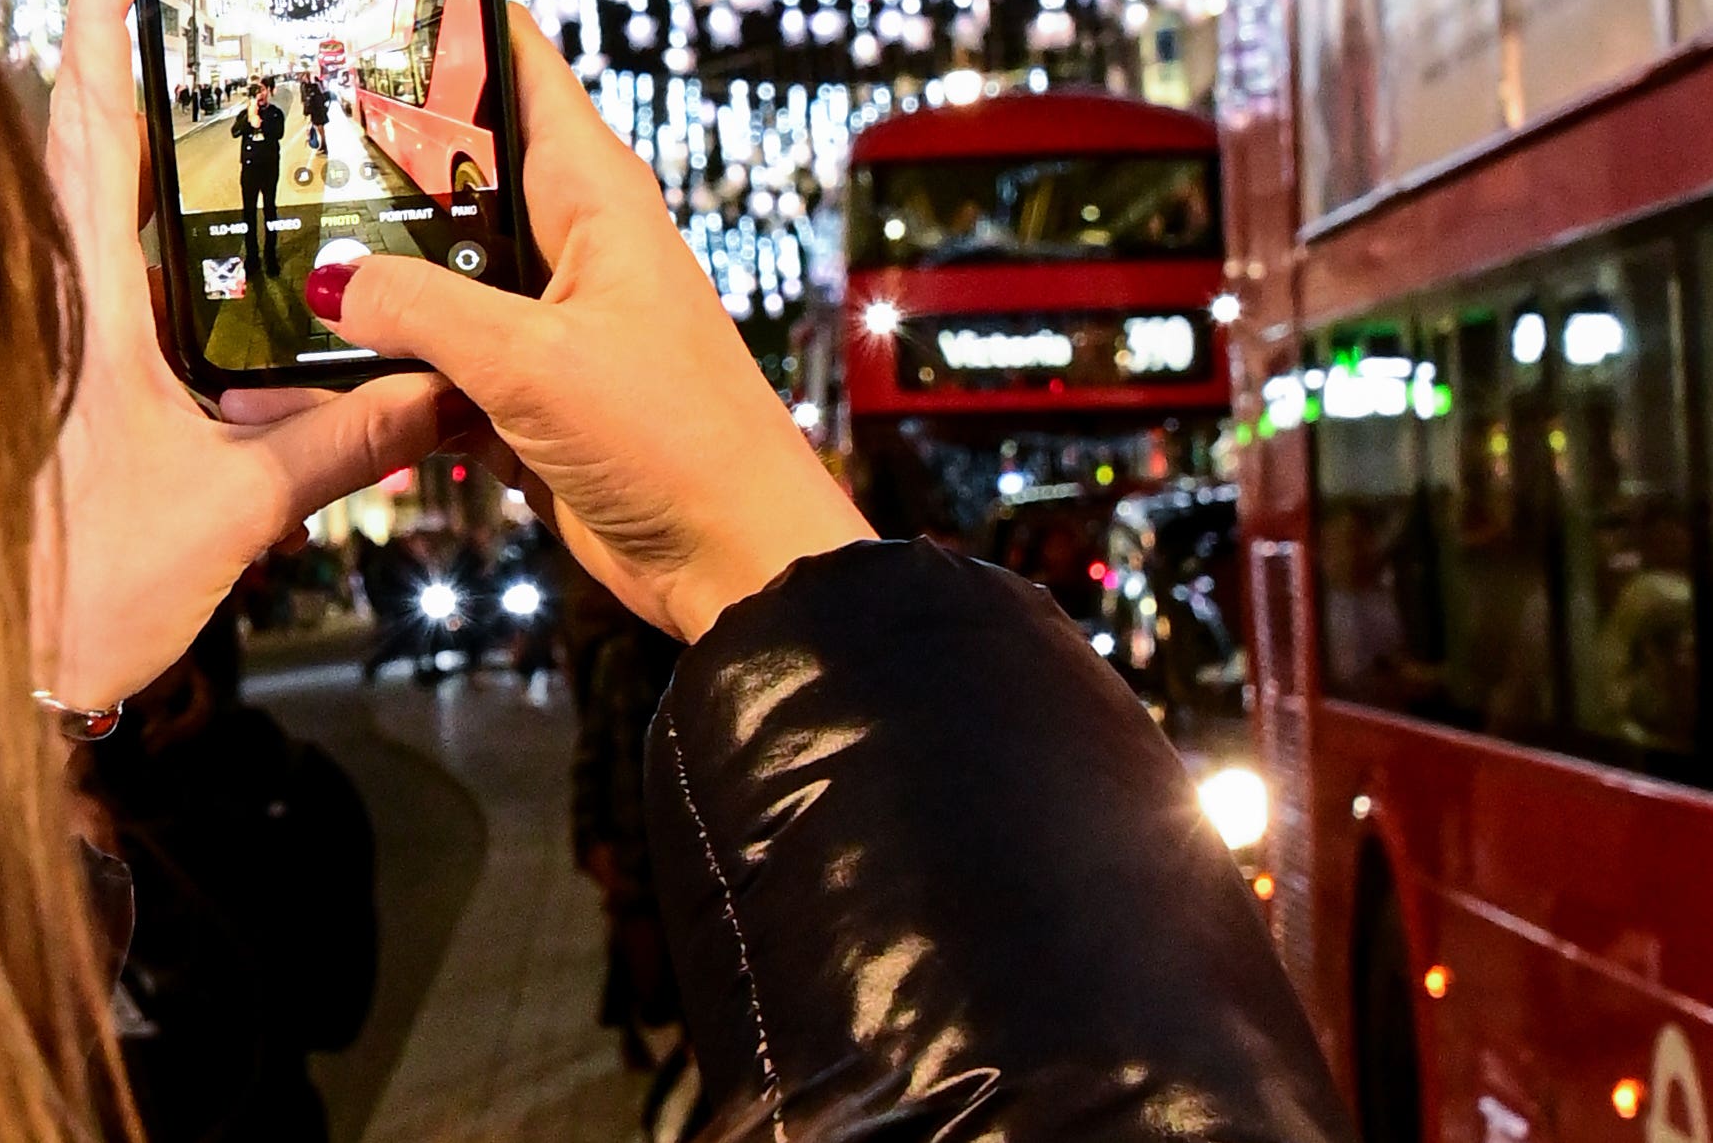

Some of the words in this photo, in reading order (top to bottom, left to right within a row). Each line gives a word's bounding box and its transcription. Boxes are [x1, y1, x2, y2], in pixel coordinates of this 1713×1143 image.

[266, 218, 302, 232] VIDEO
[320, 214, 360, 227] PHOTO
[379, 208, 433, 222] PORTRAIT
